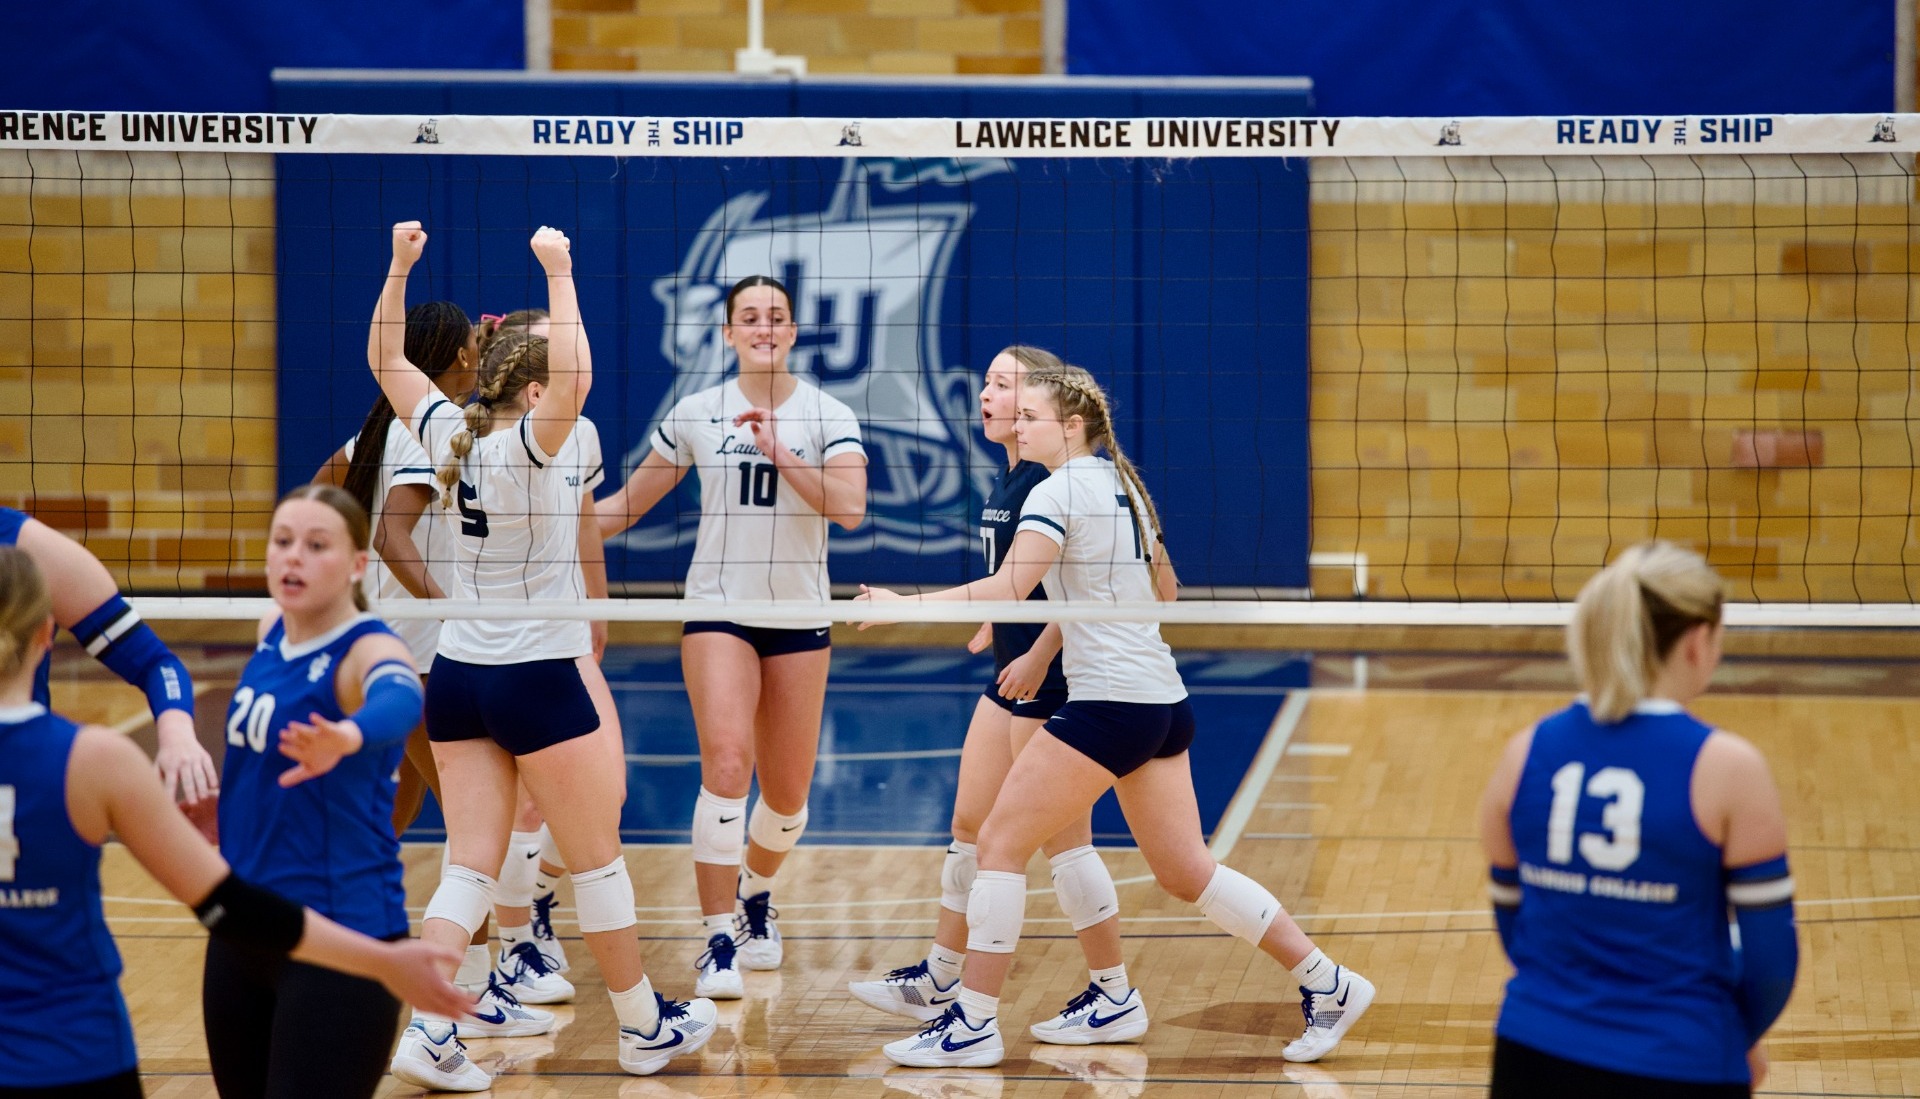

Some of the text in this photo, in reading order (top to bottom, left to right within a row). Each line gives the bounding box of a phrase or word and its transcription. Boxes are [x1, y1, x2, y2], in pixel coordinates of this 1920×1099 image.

[0, 112, 318, 144] RENCE UNIVERSITY
[533, 119, 743, 147] READY THE SHIP
[956, 120, 1340, 148] LAWRENCE UNIVERSITY
[1557, 118, 1773, 145] READY THE SHIP
[738, 461, 779, 507] 10
[458, 479, 490, 538] 5
[227, 686, 276, 754] 20
[1546, 761, 1645, 872] 13
